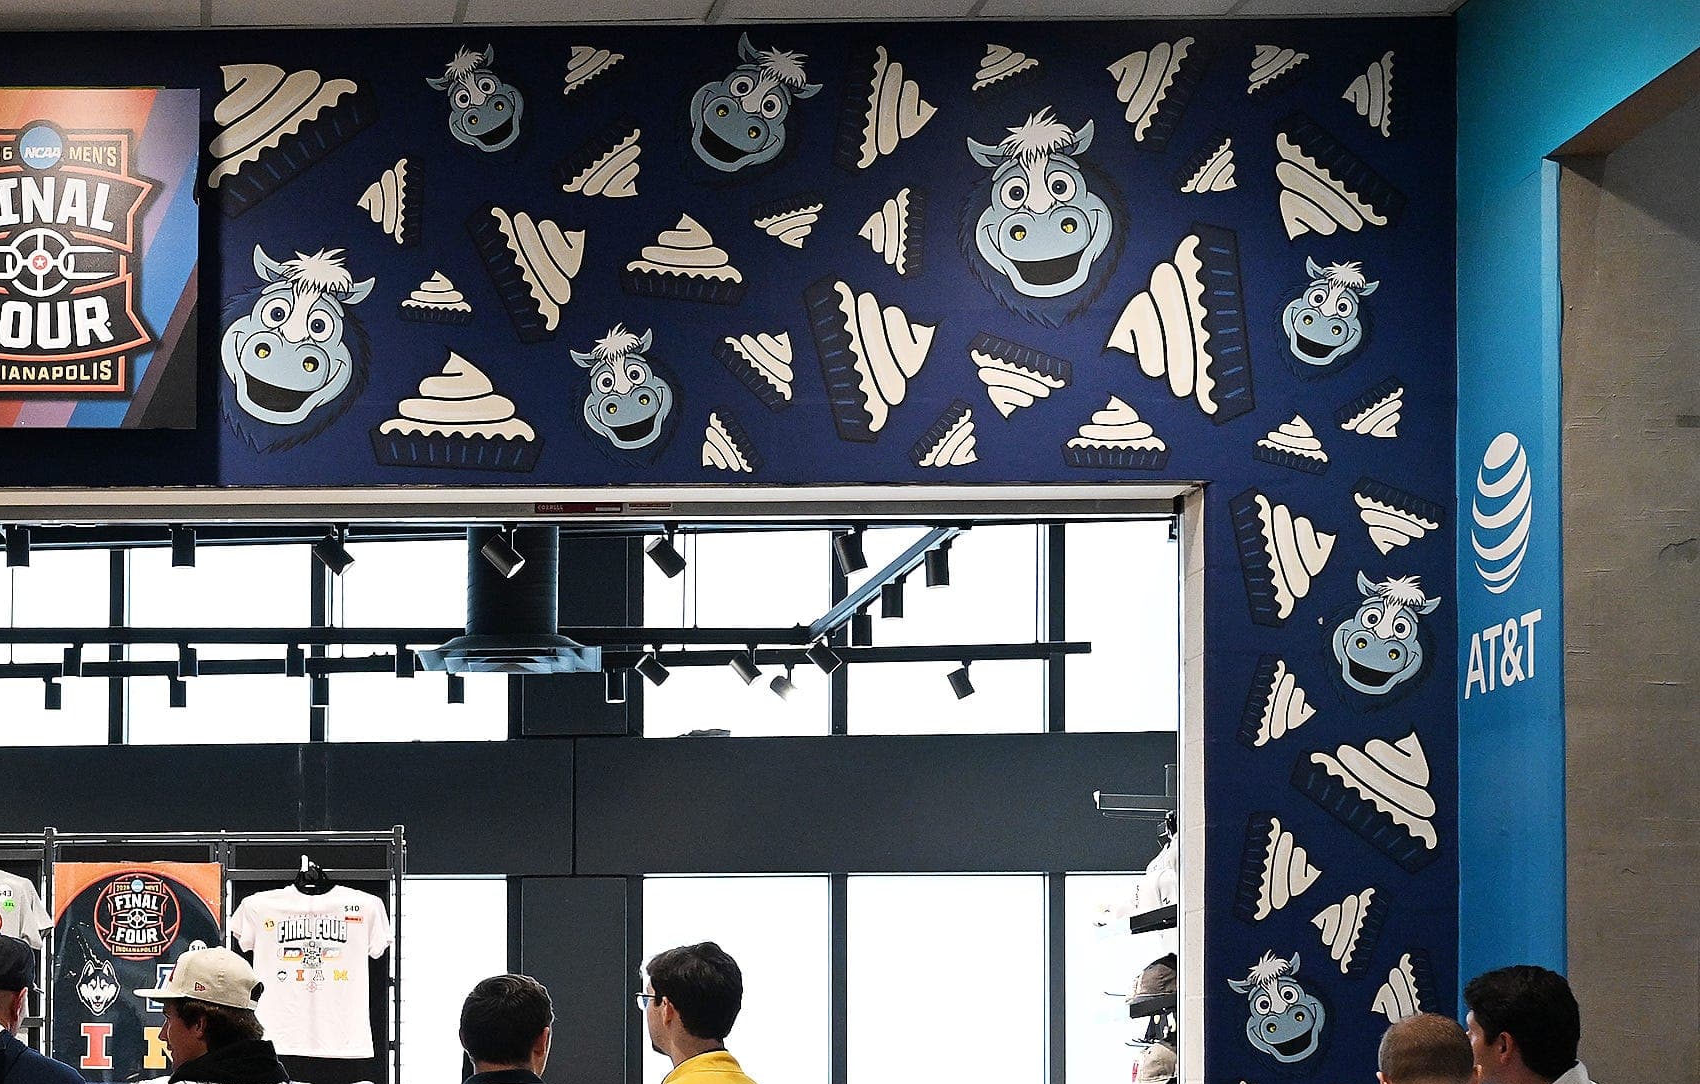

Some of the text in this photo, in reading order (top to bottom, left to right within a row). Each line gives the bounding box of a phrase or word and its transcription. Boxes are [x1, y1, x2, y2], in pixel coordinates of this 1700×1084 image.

[24, 146, 61, 160] NCAA
[69, 146, 117, 167] MEN'S
[1464, 608, 1543, 700] AT&T
[115, 893, 159, 911] FINAL
[265, 920, 275, 928] 13
[277, 918, 347, 943] FINAL FOUR
[115, 927, 159, 944] FOUR
